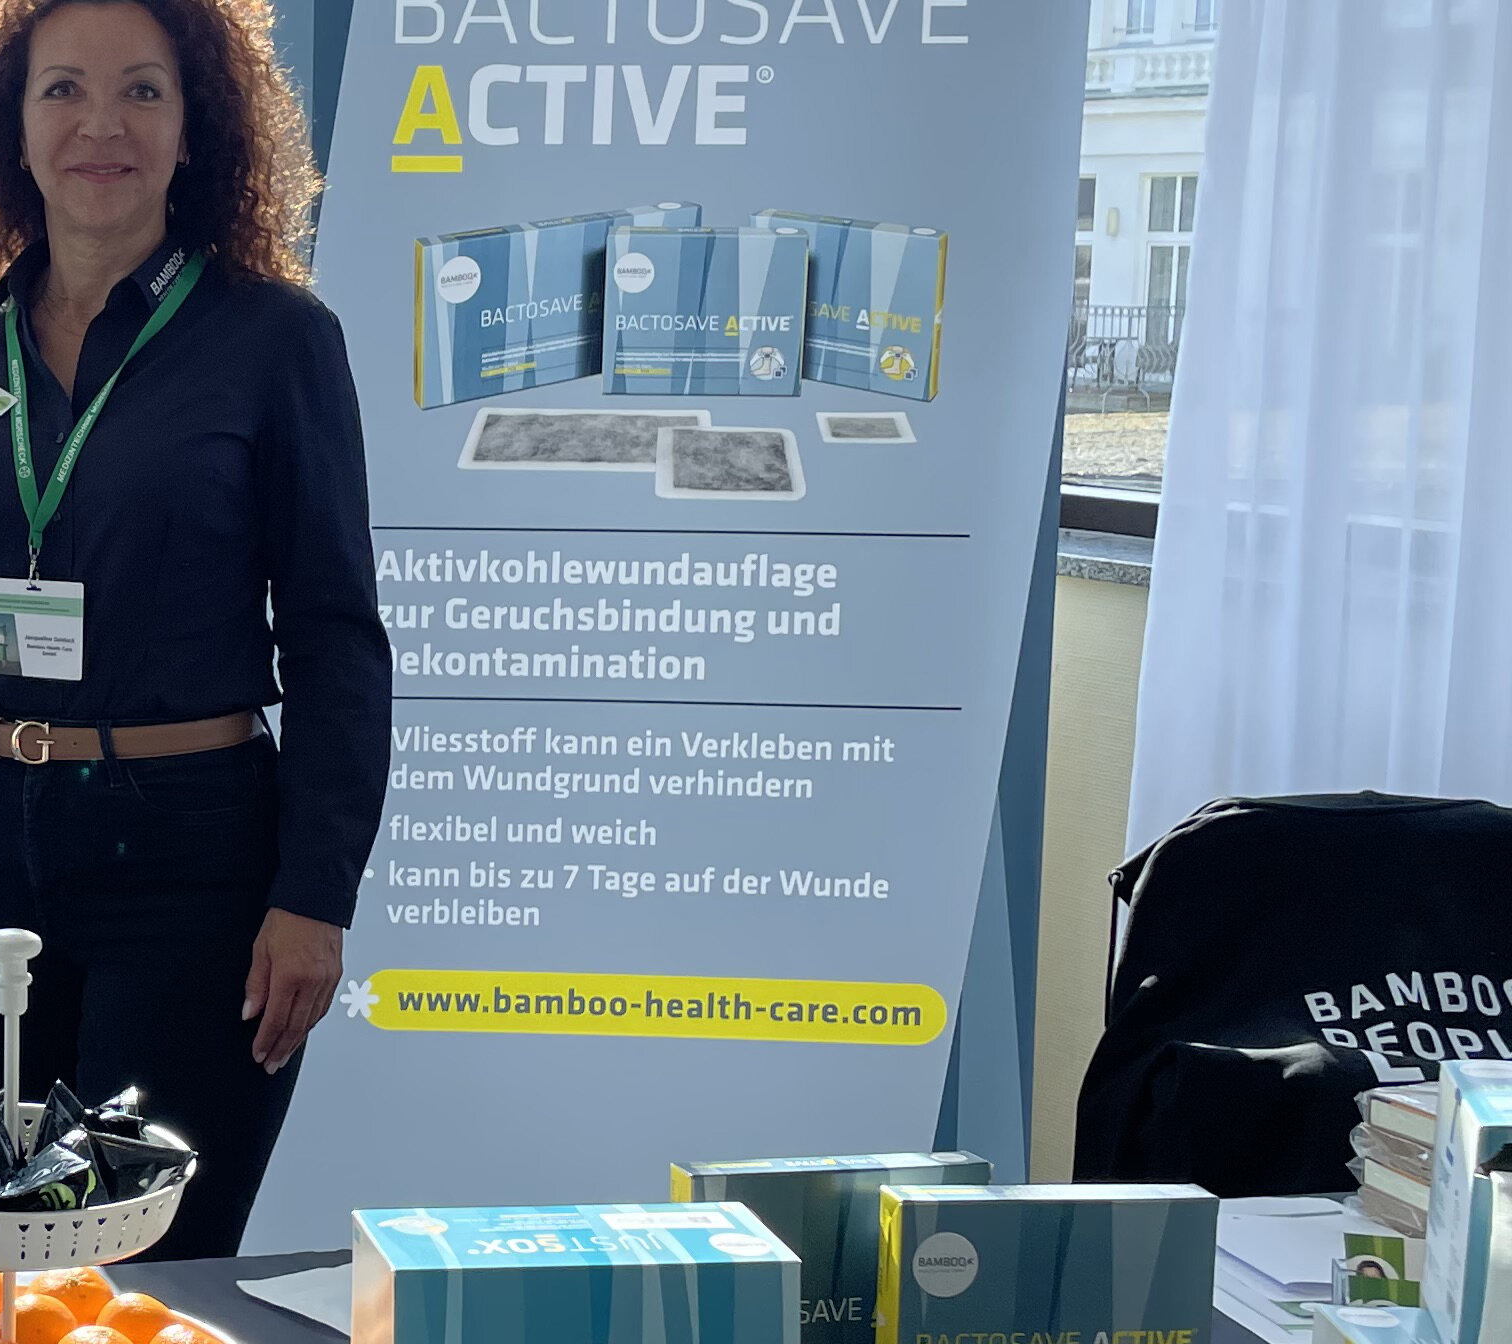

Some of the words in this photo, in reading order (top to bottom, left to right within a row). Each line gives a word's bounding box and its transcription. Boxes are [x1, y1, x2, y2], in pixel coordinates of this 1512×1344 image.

[149, 252, 185, 297] BAMBOO
[480, 293, 584, 328] BACTOSAVE
[614, 314, 720, 332] BACTOSAVE
[376, 549, 838, 596] Aktivkohlewundauflage
[377, 603, 435, 630] zur
[444, 596, 756, 643] Geruchsbindung
[766, 602, 841, 638] und
[390, 642, 706, 681] ekontamination
[392, 725, 536, 754] Vliesstoff
[544, 727, 619, 757] kann
[626, 729, 672, 758] ein
[681, 731, 833, 762] Verkleben
[842, 735, 895, 764] mit
[390, 763, 455, 792] dem
[463, 764, 641, 799] Wundgrund
[648, 769, 814, 799] verhindern
[389, 814, 497, 843] flexibel
[506, 816, 563, 844] und
[571, 817, 658, 847] weich
[388, 859, 461, 889] kann
[468, 862, 512, 890] bis
[520, 869, 555, 891] zu
[562, 864, 580, 890] 7
[587, 865, 657, 898] Tage
[664, 866, 715, 895] auf
[721, 867, 771, 896] der
[779, 869, 890, 899] Wunde
[386, 898, 541, 927] verbleiben
[397, 985, 923, 1029] www.bamboo-health-care.com
[917, 1256, 968, 1268] BAMBOO
